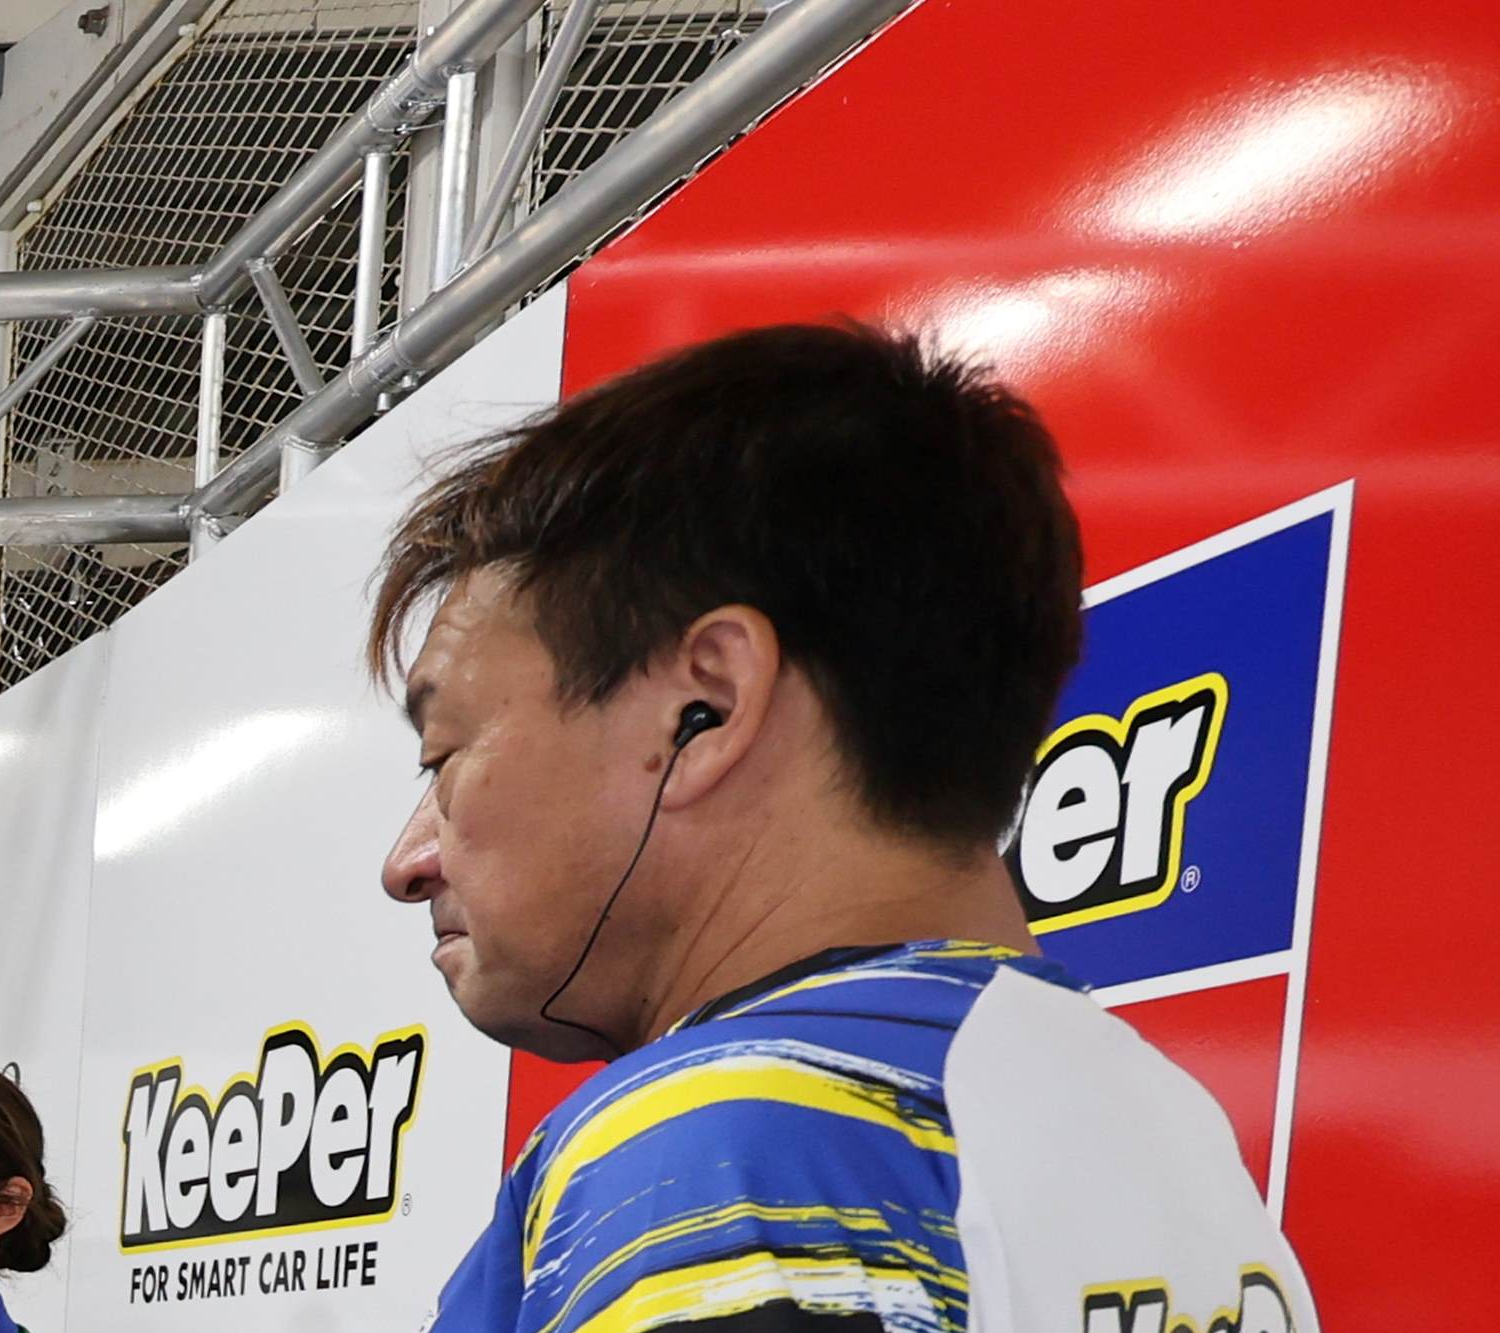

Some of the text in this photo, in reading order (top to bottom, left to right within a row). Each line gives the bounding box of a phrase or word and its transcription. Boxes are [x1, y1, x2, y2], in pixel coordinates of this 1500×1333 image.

[997, 703, 1207, 905] er
[119, 1036, 422, 1240] KeePer
[129, 1241, 380, 1304] FOR SMART CAR LIFE
